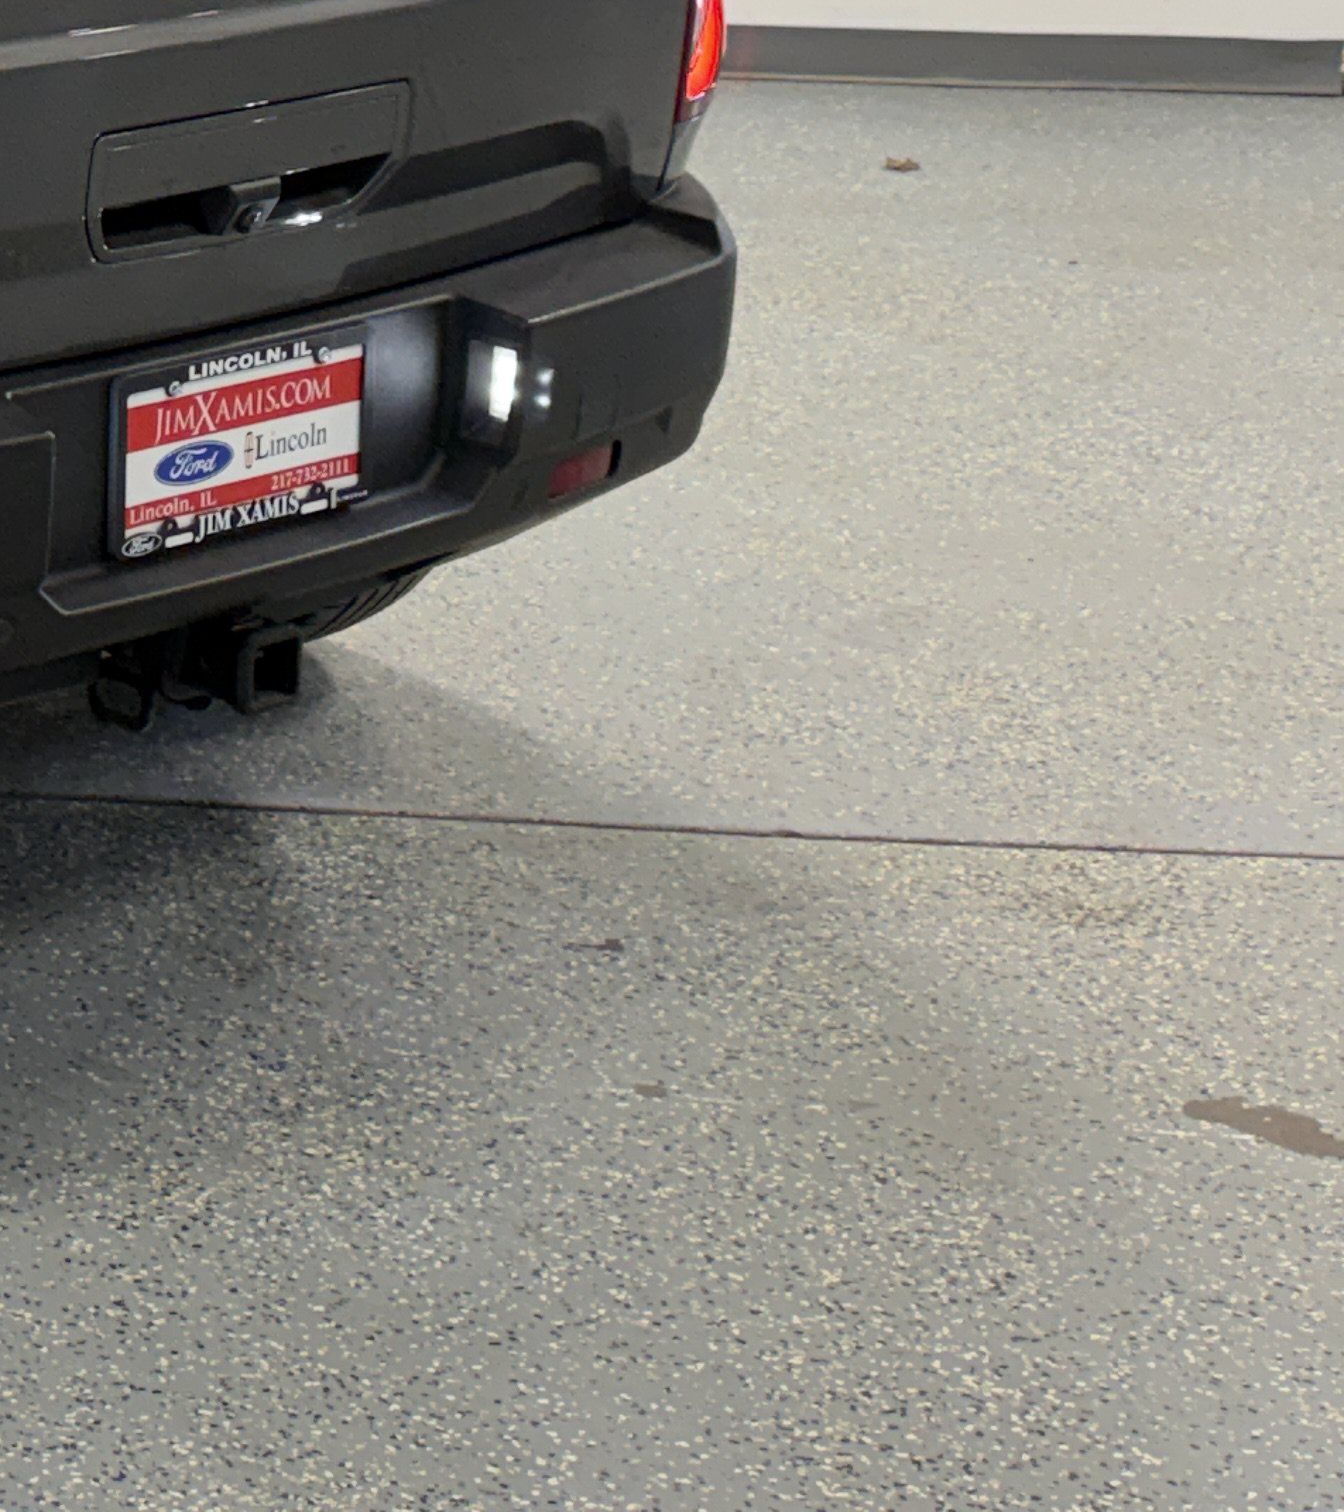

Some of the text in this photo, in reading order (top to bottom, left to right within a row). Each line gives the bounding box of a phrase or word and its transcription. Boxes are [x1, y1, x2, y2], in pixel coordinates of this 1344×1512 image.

[188, 341, 313, 381] LINCOLN, IL
[154, 374, 332, 444] JIMXAMIS.COM
[168, 422, 327, 479] Ford Lincoln
[271, 457, 349, 491] 217-732-2111
[195, 508, 232, 543] JIM
[238, 493, 300, 526] XAMIS
[200, 490, 217, 508] IL
